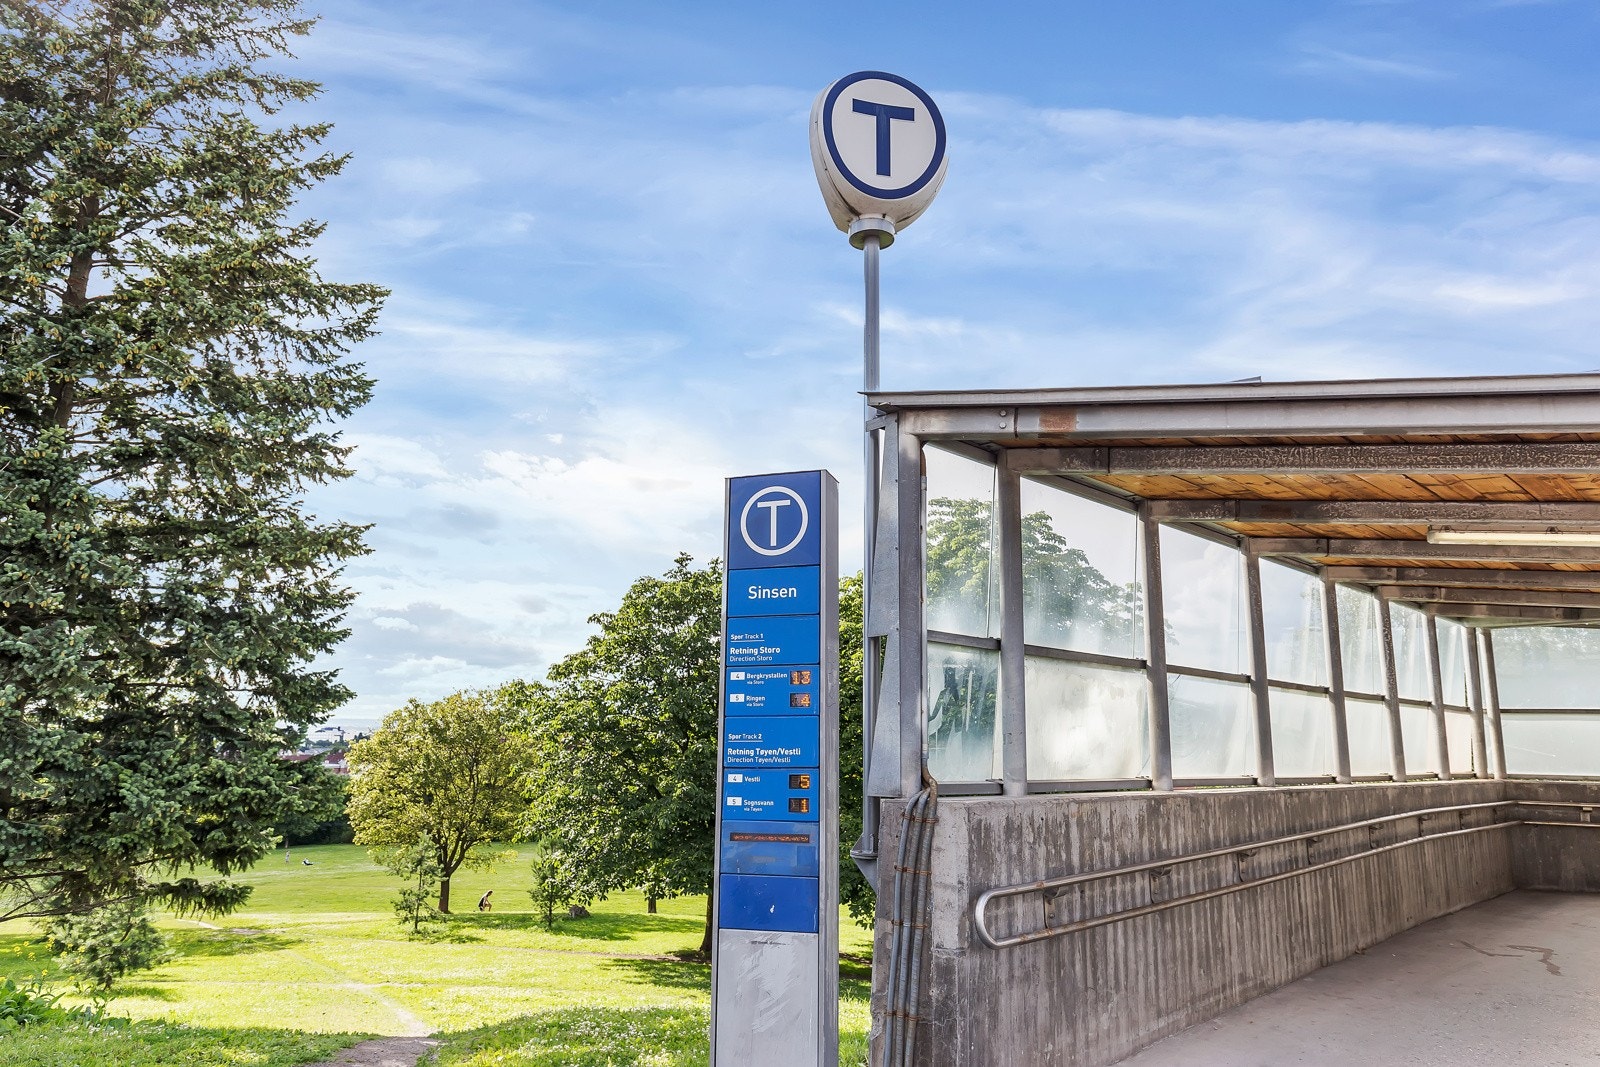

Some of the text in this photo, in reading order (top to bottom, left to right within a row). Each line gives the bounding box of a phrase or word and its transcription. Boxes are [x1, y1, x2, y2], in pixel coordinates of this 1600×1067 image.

[852, 98, 915, 176] T
[757, 499, 791, 547] T
[748, 586, 797, 599] Sinsen
[730, 646, 781, 655] Retning Storo
[746, 672, 788, 680] Bergkrystallen
[793, 671, 811, 685] 13
[727, 747, 801, 756] Retning Tøyen/Vestli
[755, 756, 791, 764] Tøyen/Vestli
[800, 775, 810, 789] 5
[801, 799, 808, 813] 1
